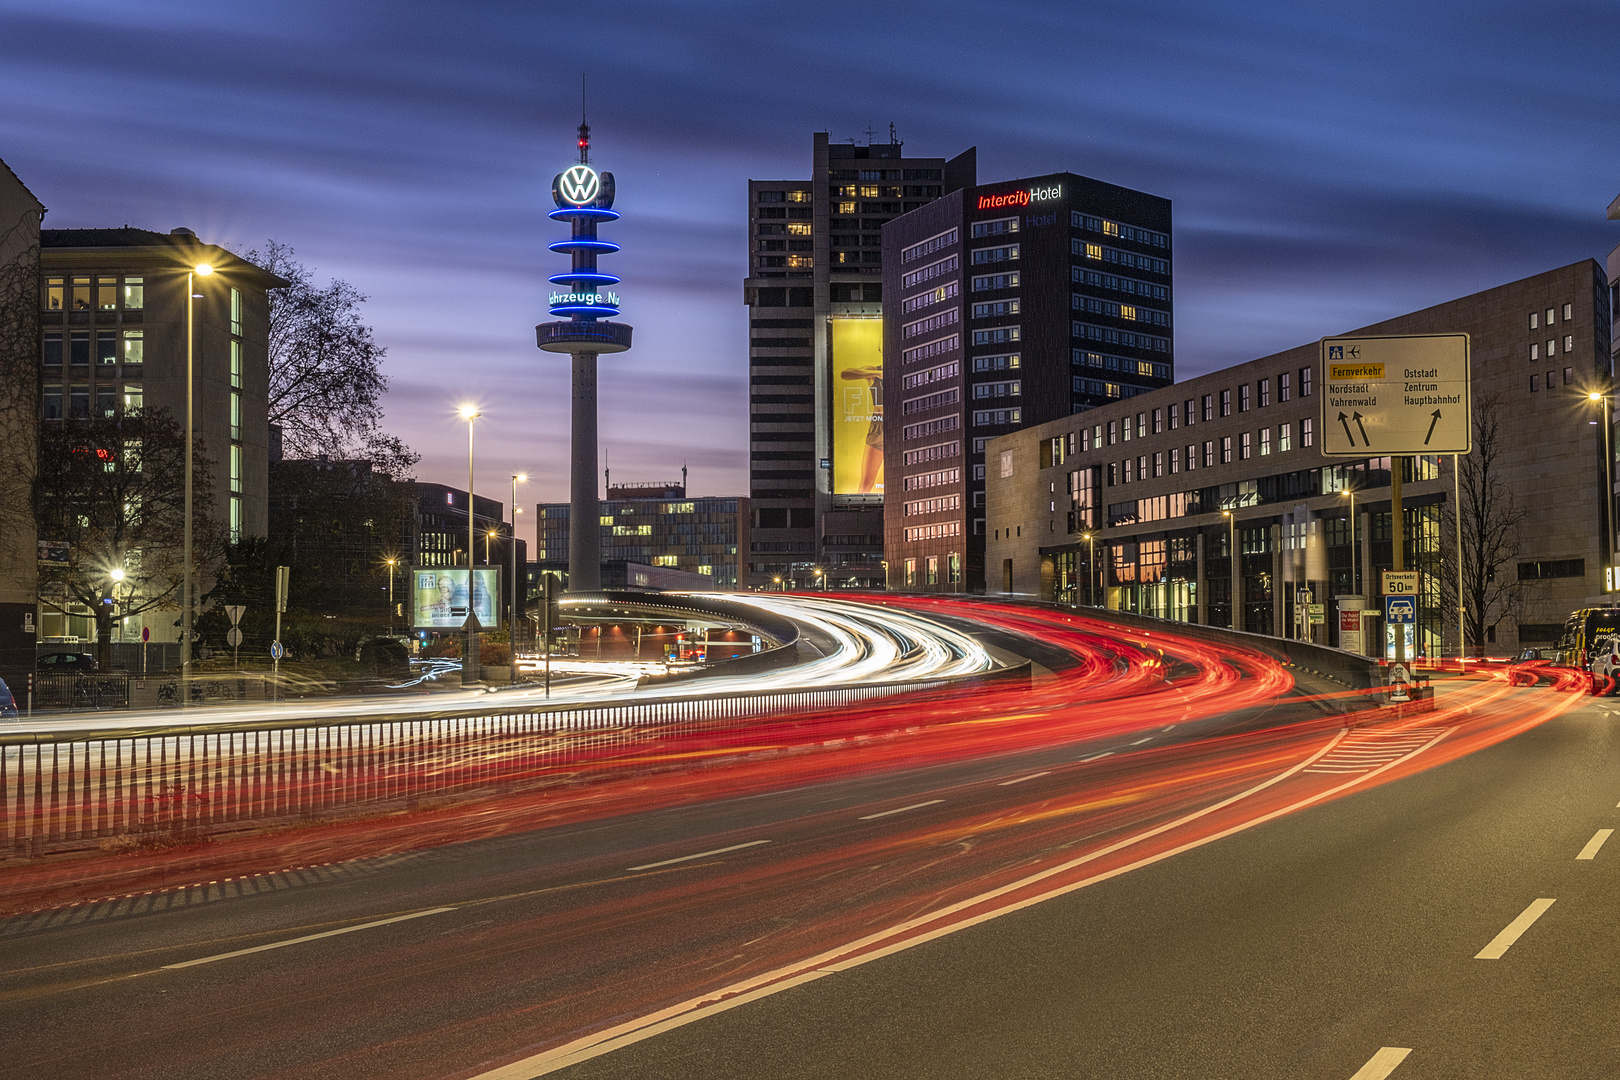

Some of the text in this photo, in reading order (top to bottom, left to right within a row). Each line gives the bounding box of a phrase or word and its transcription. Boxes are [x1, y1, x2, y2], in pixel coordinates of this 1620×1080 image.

[977, 184, 1062, 209] IntercityHotel
[1332, 366, 1382, 377] Fernverkehr
[1404, 368, 1438, 379] Oststadt
[1329, 384, 1369, 394] Nordstadt
[1404, 382, 1438, 392] Zentrum
[1329, 396, 1377, 407] Vahrenwald
[1404, 394, 1461, 407] Hauptbahnhof
[1389, 581, 1404, 593] 50
